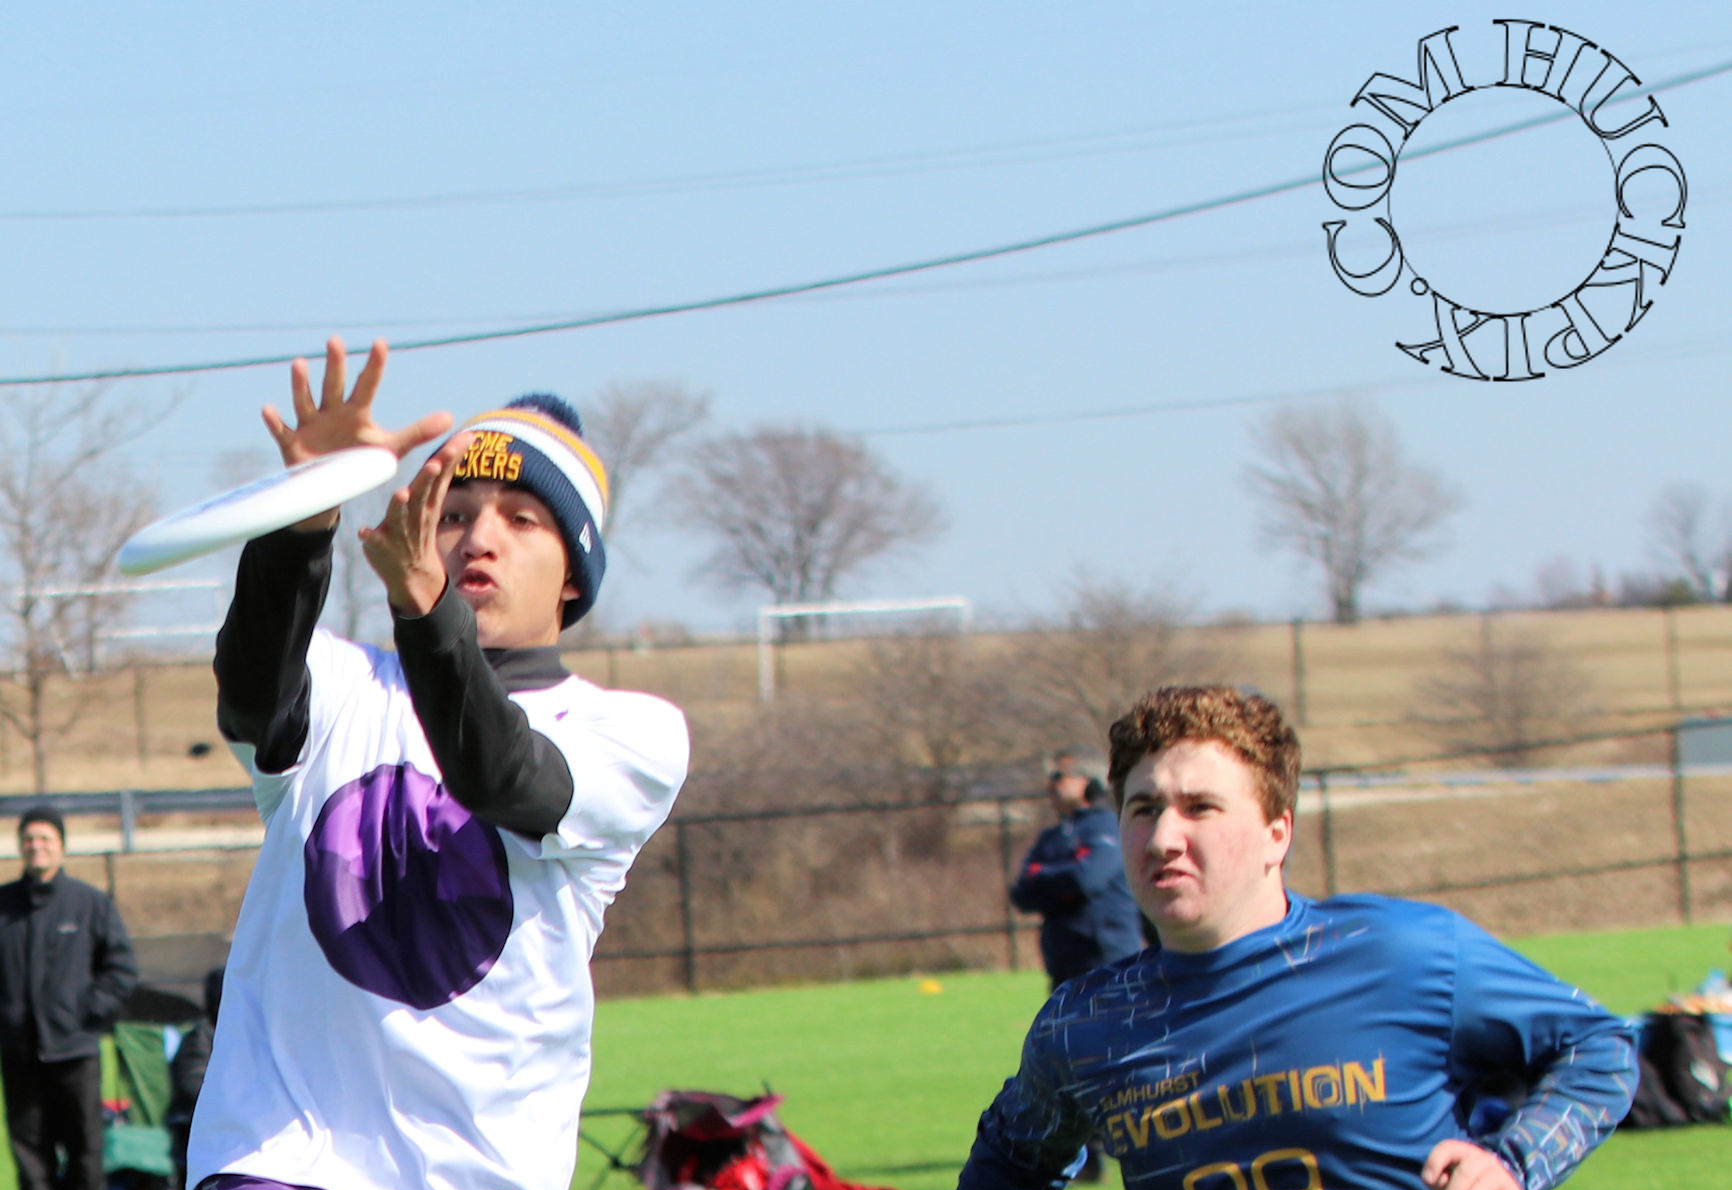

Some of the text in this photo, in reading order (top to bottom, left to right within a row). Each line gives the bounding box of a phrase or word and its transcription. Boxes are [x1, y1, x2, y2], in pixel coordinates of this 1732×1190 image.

[468, 431, 514, 452] CME
[455, 450, 523, 481] CKERS
[1105, 1056, 1388, 1155] EVOLUTION
